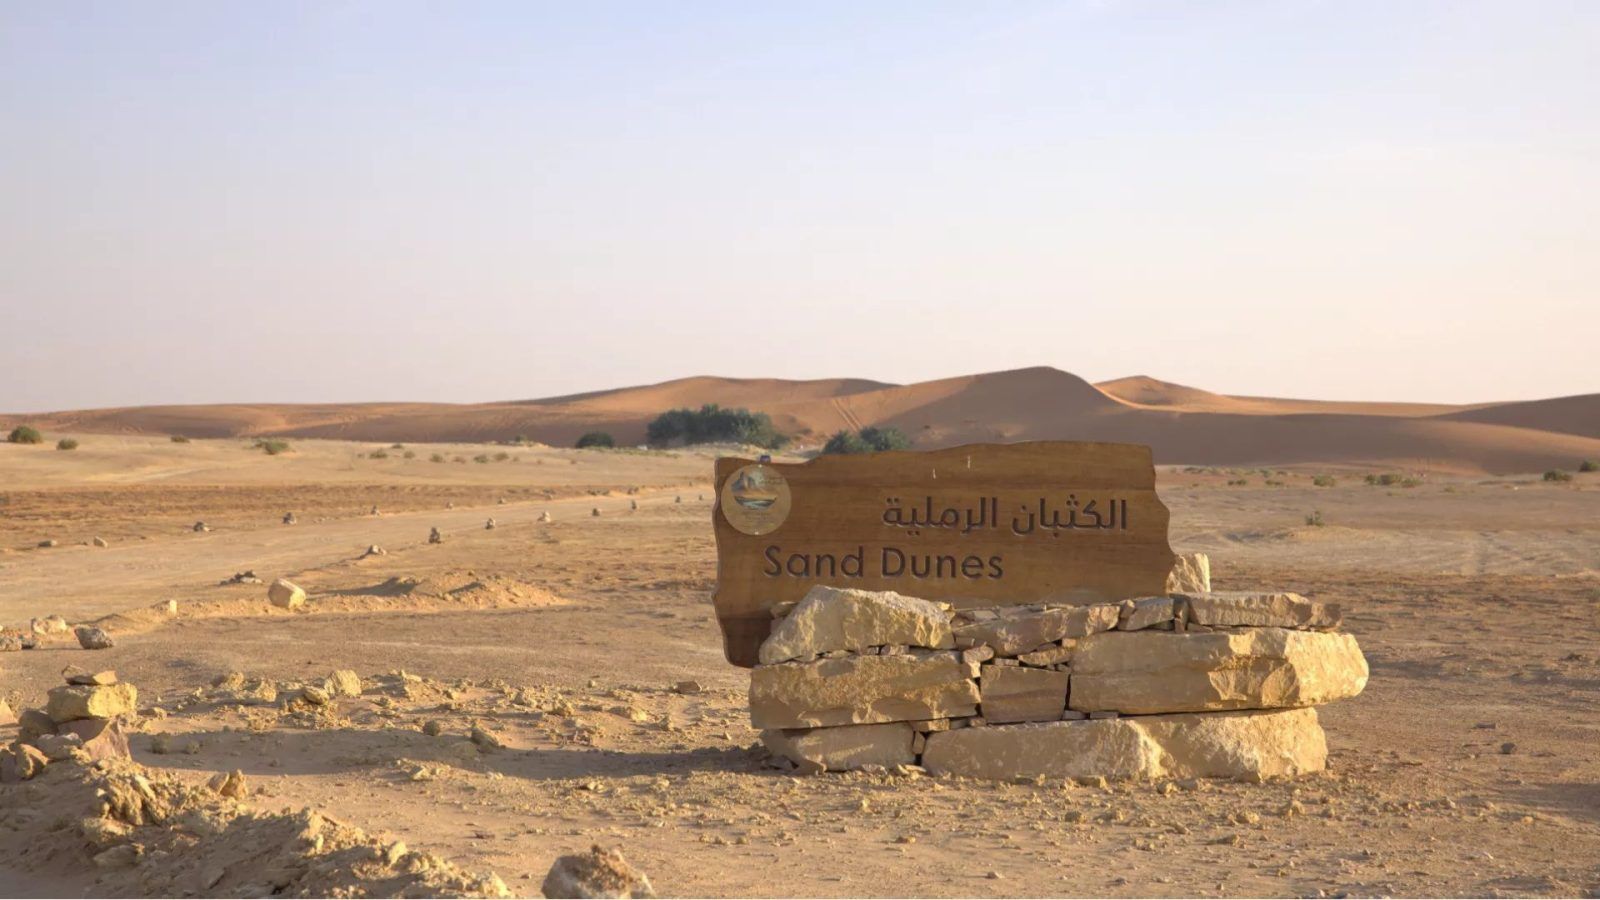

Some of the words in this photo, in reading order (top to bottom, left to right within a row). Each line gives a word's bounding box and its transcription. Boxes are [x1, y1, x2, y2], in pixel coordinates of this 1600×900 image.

[882, 496, 997, 536] الرملية
[1012, 494, 1127, 539] الكثبان
[763, 546, 864, 578] Sand
[881, 547, 1004, 579] Dunes
